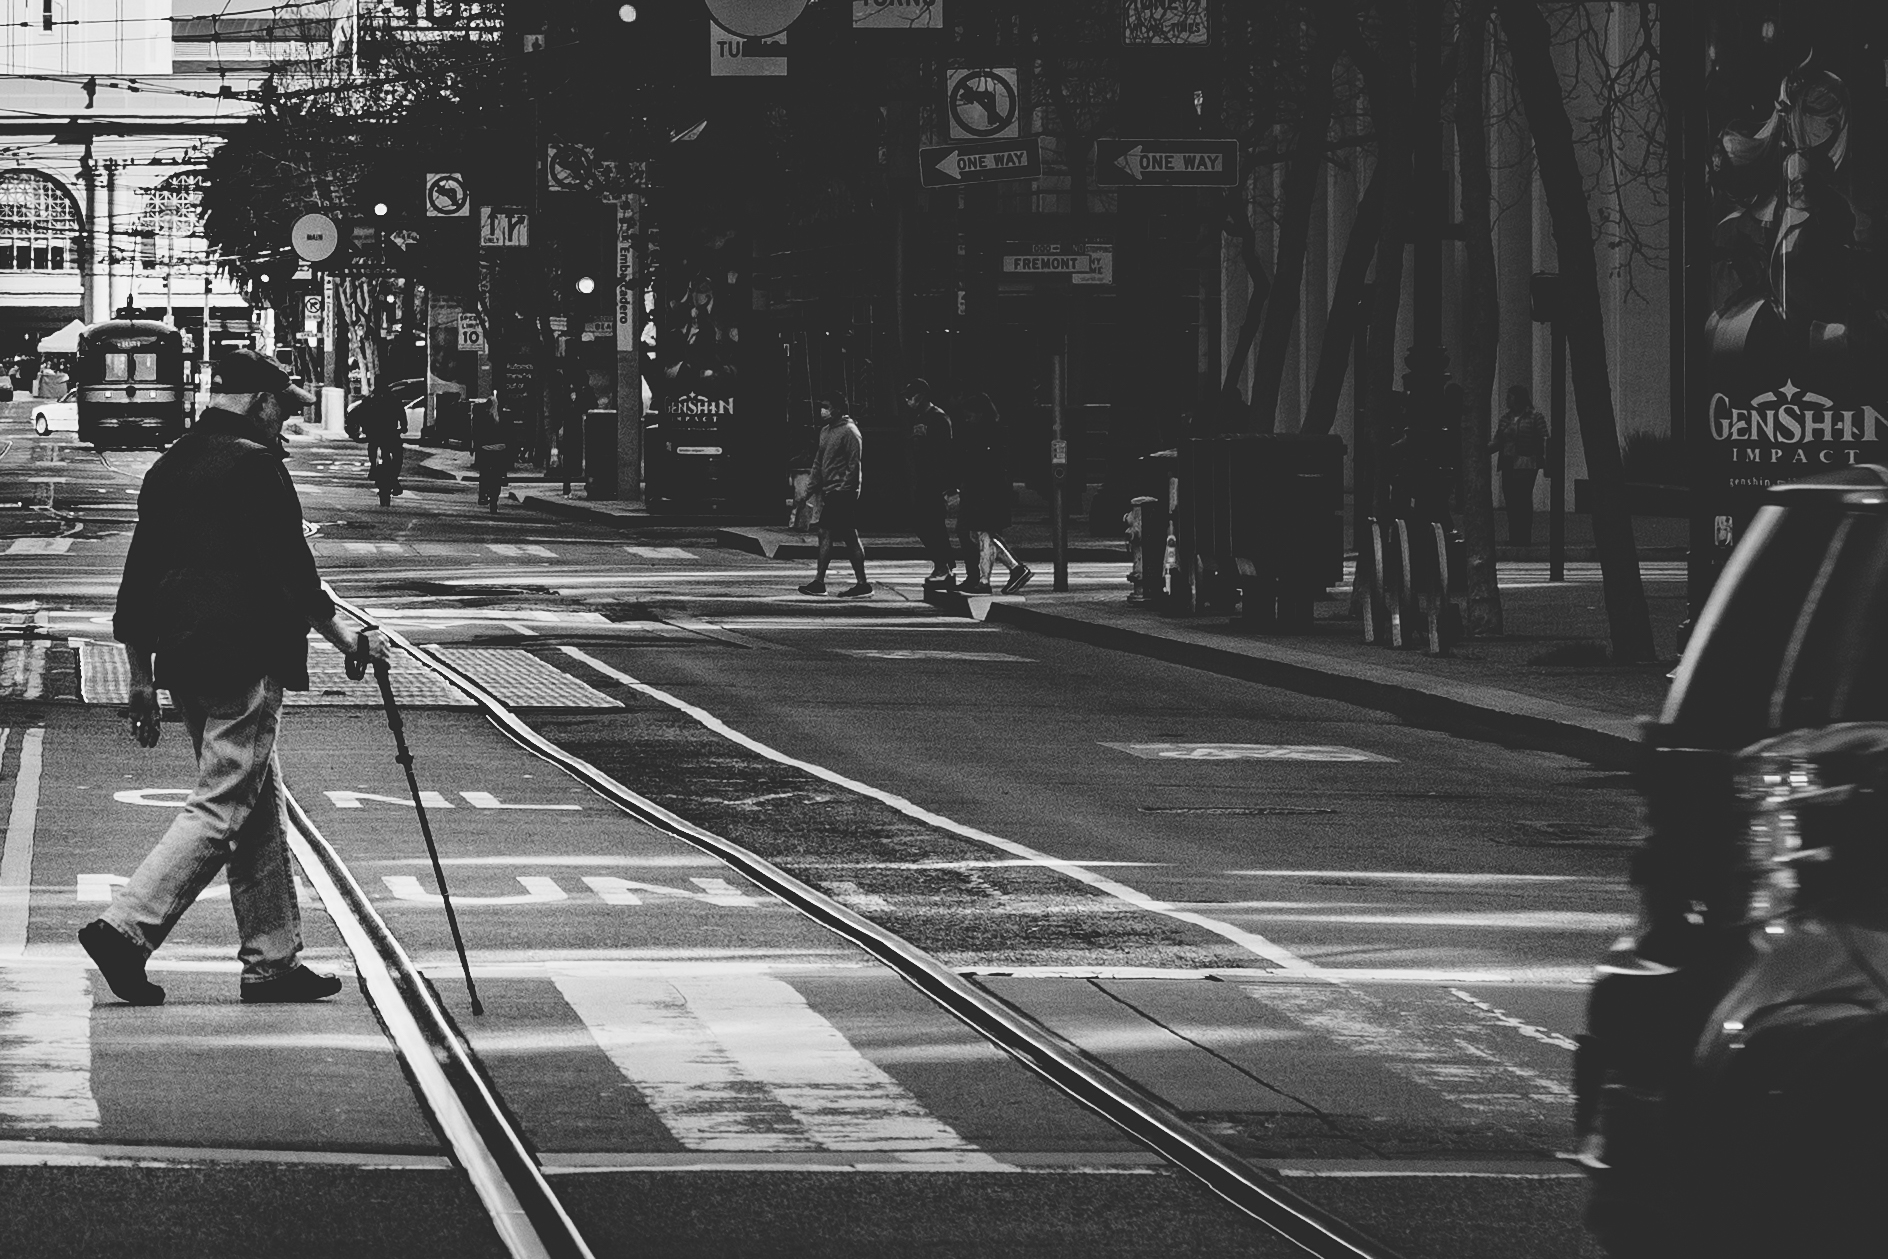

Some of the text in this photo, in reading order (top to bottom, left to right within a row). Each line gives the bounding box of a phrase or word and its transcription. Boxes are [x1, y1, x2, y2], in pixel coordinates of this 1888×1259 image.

[957, 151, 1026, 172] ONE WAY
[1140, 154, 1222, 171] ONE WAY
[1013, 257, 1079, 271] FREMONT
[618, 246, 631, 325] Embacadero
[462, 330, 480, 344] 10
[1709, 392, 1888, 444] GENSHIN
[1731, 447, 1861, 466] IMPACT
